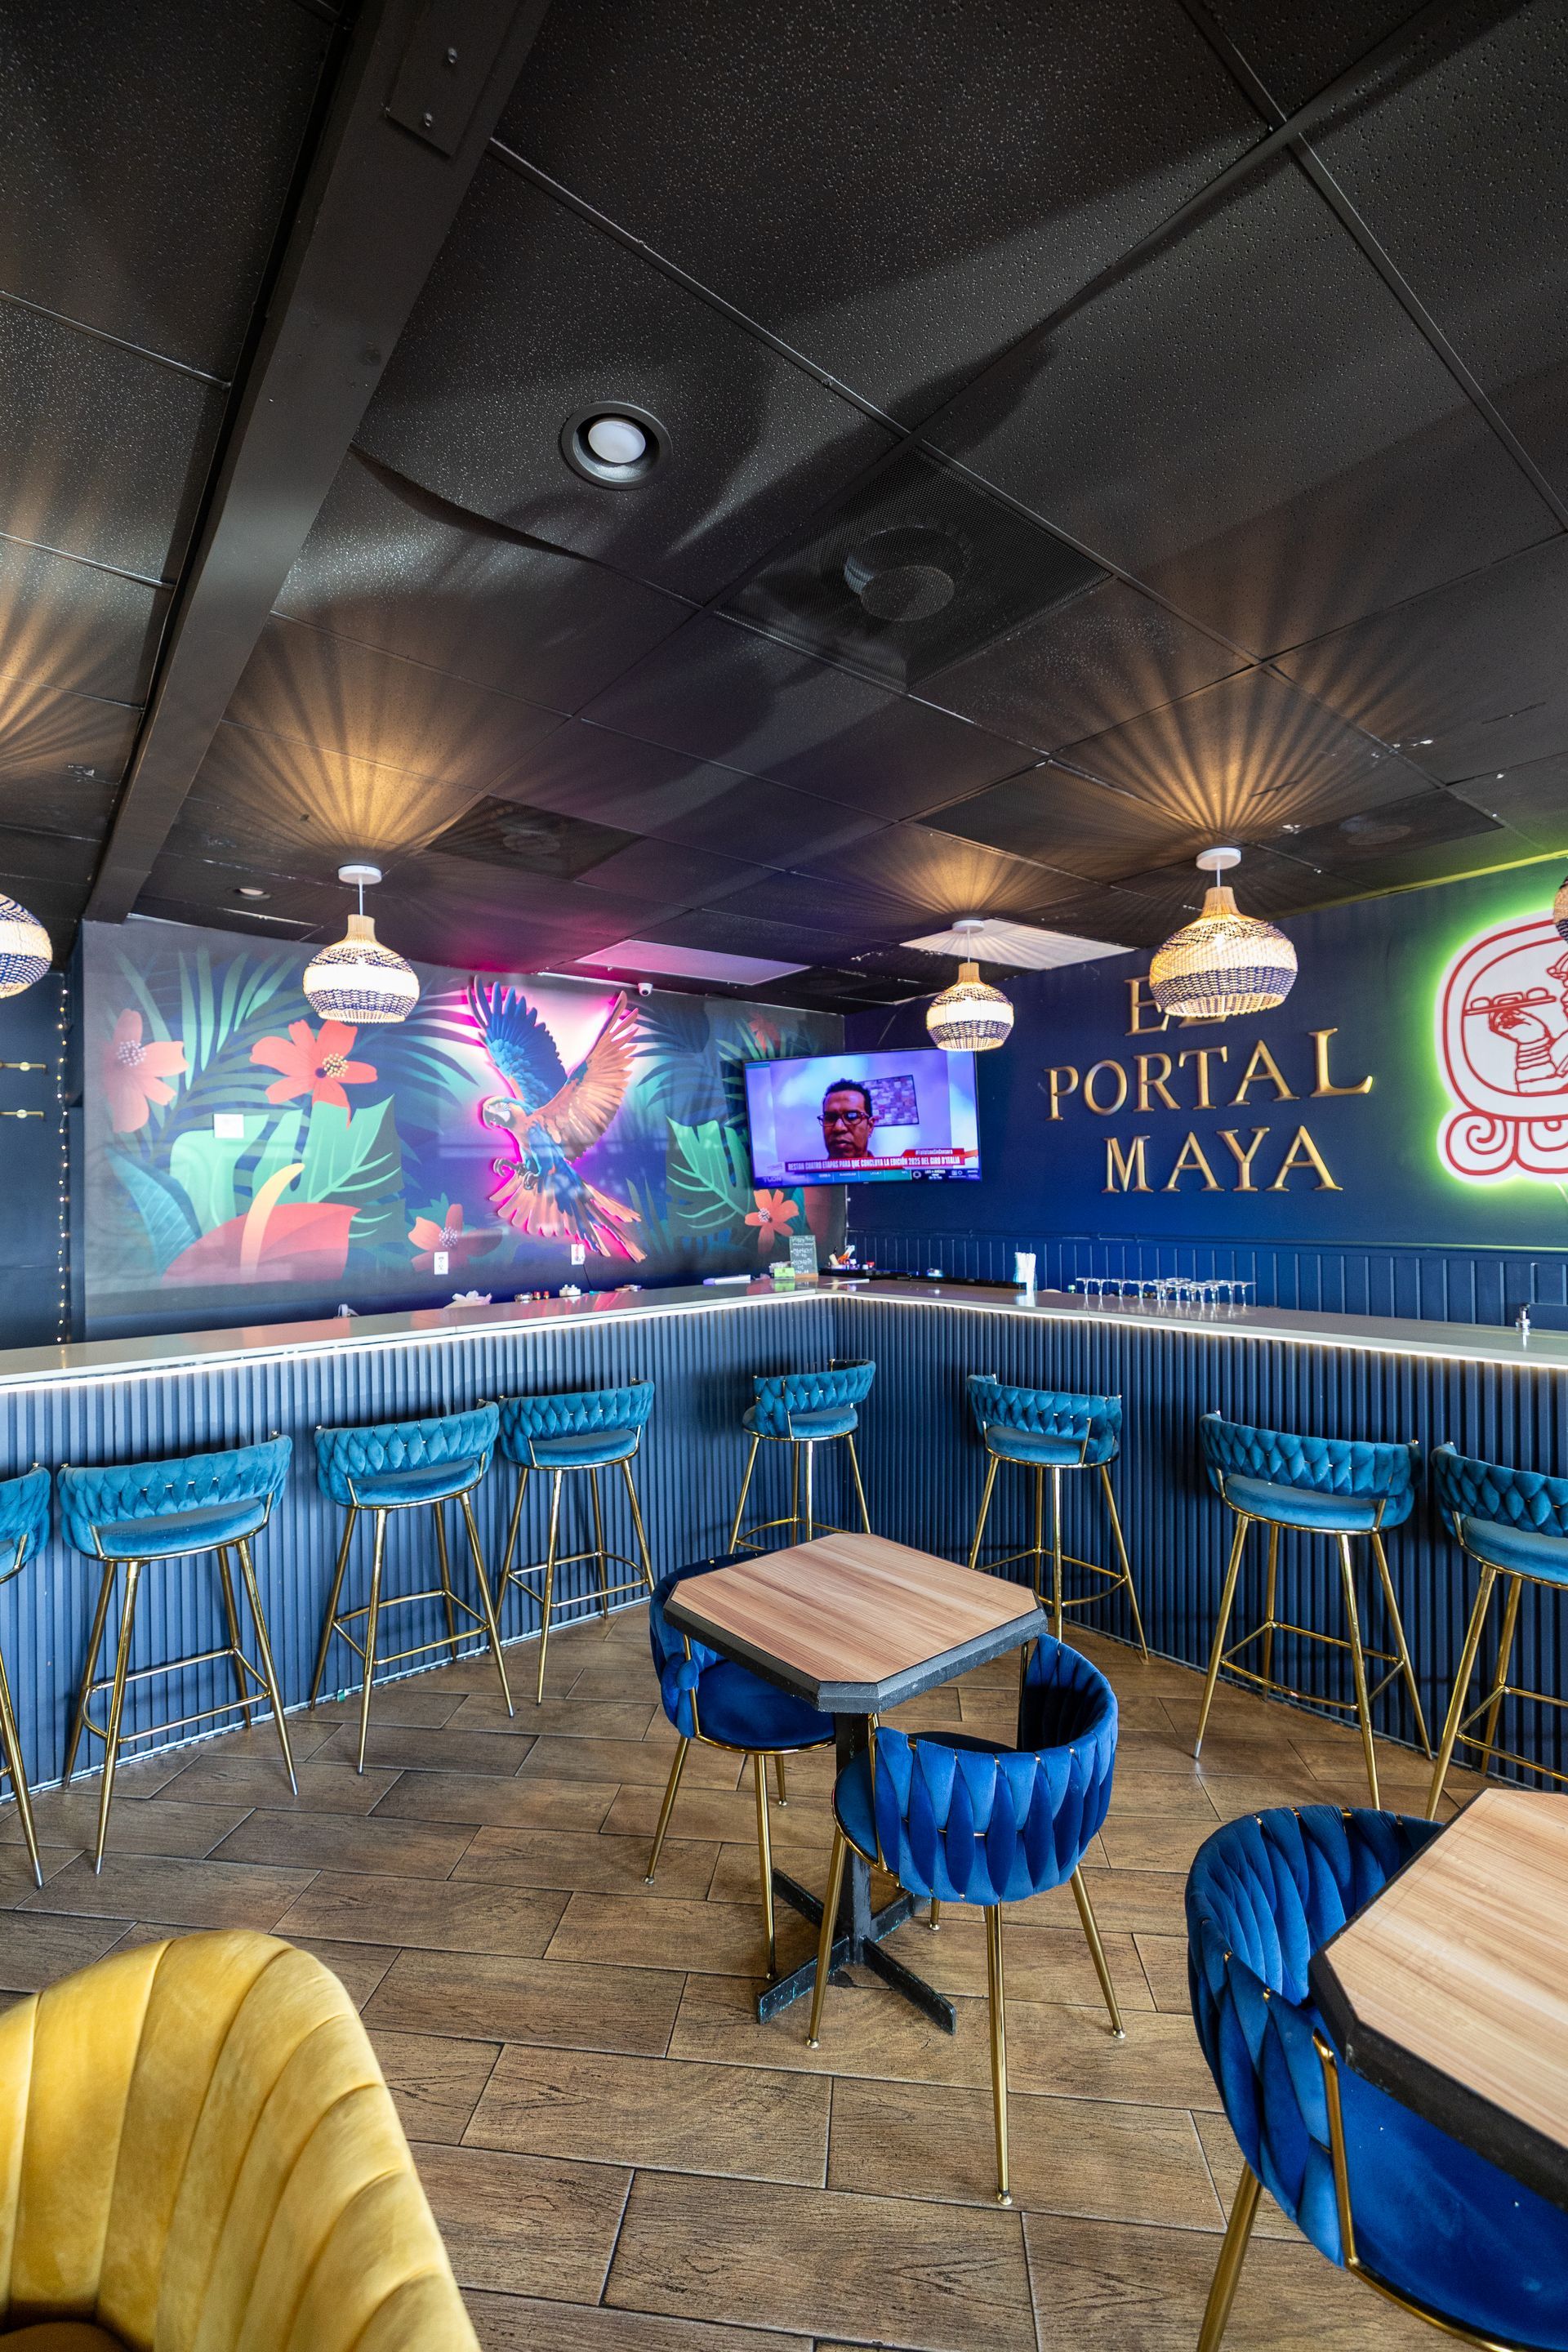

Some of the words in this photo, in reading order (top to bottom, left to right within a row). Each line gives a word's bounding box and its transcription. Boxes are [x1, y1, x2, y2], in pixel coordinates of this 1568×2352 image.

[1125, 976, 1227, 1036] E
[1044, 1027, 1374, 1121] PORTAL
[839, 1160, 851, 1168] PARA
[851, 1159, 861, 1169] QUE
[861, 1158, 884, 1167] CONCLUYA
[884, 1157, 890, 1165] LA
[909, 1156, 920, 1165] 2025
[921, 1156, 929, 1165] DEL
[929, 1156, 941, 1165] GIRO
[1101, 1125, 1343, 1194] MAYA
